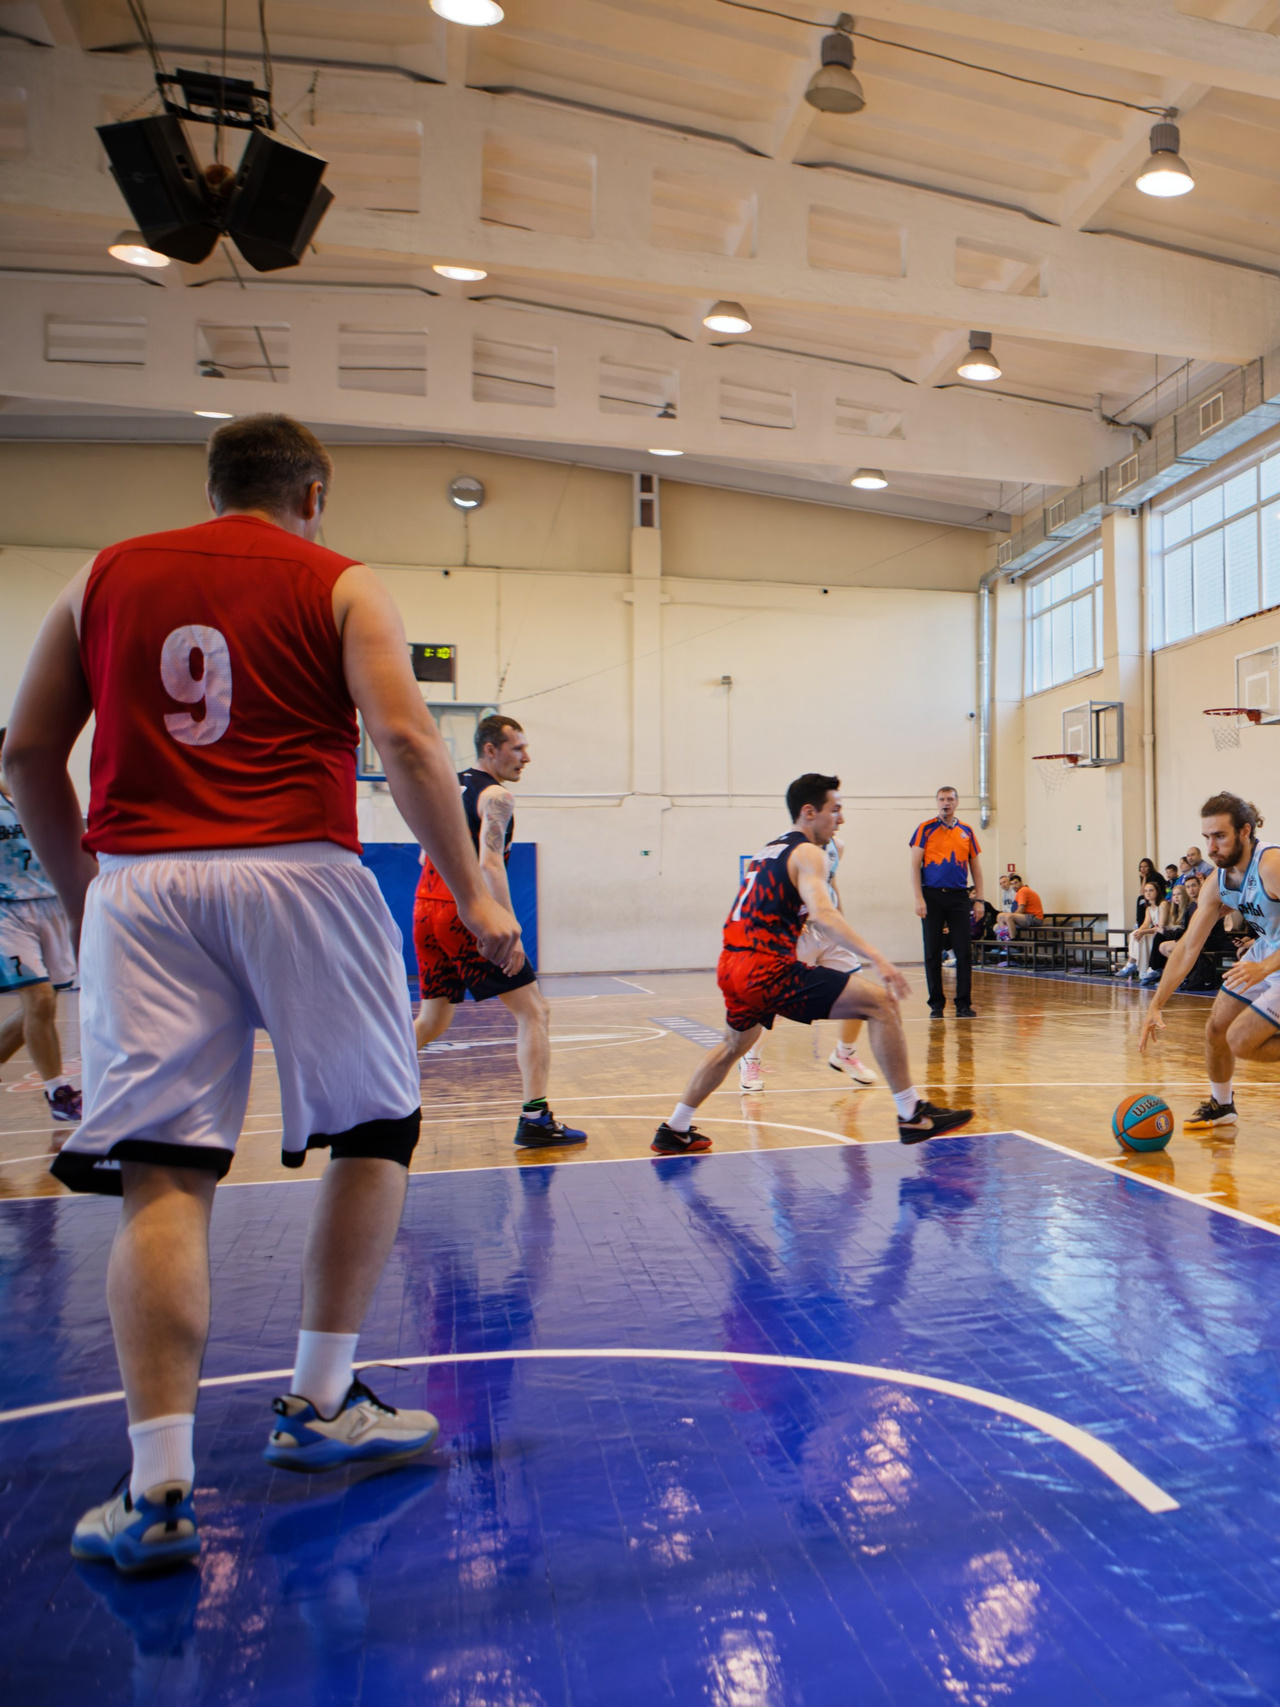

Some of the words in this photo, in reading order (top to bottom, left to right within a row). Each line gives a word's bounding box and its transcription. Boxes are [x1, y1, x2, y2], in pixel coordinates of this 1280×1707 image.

[160, 624, 232, 746] 9
[22, 849, 32, 871] 7
[10, 955, 22, 977] 7
